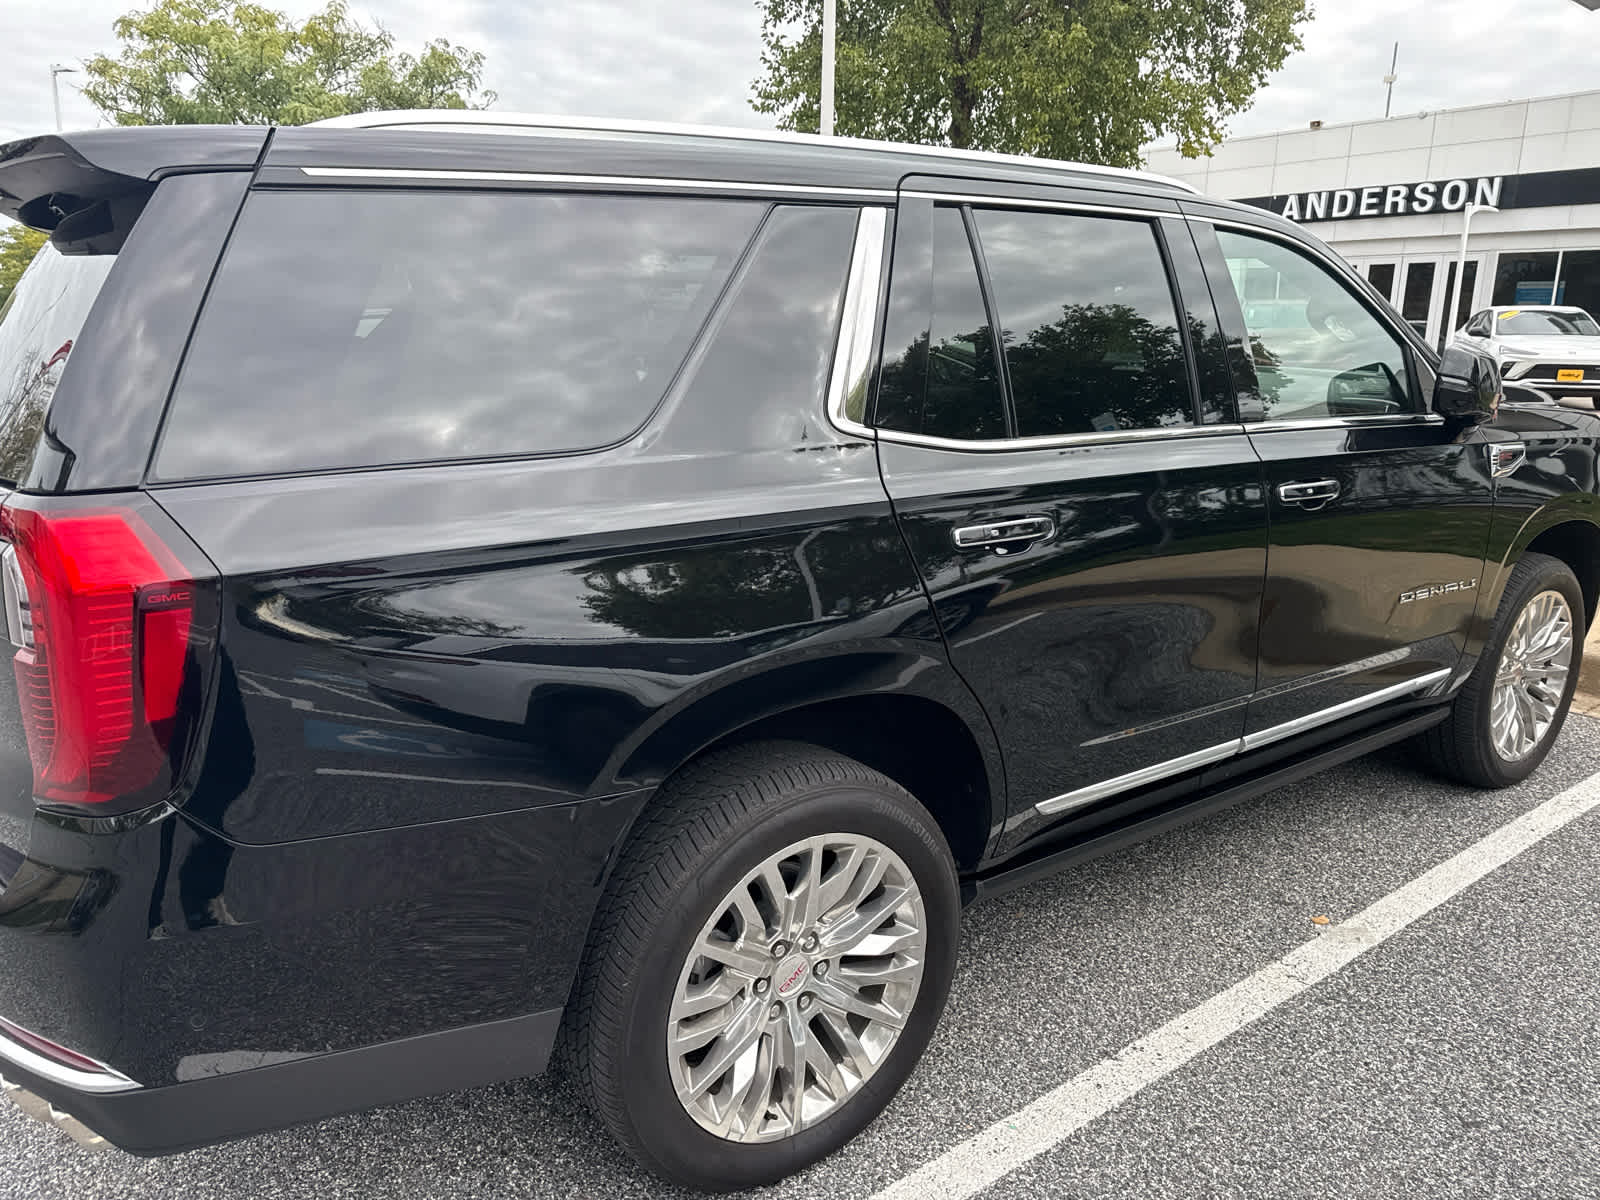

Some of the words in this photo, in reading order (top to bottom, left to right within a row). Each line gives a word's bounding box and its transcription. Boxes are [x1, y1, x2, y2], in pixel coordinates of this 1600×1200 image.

[1281, 176, 1502, 221] ANDERSON
[147, 591, 191, 604] GMC
[1399, 578, 1477, 604] DENALI
[779, 961, 807, 992] GMC
